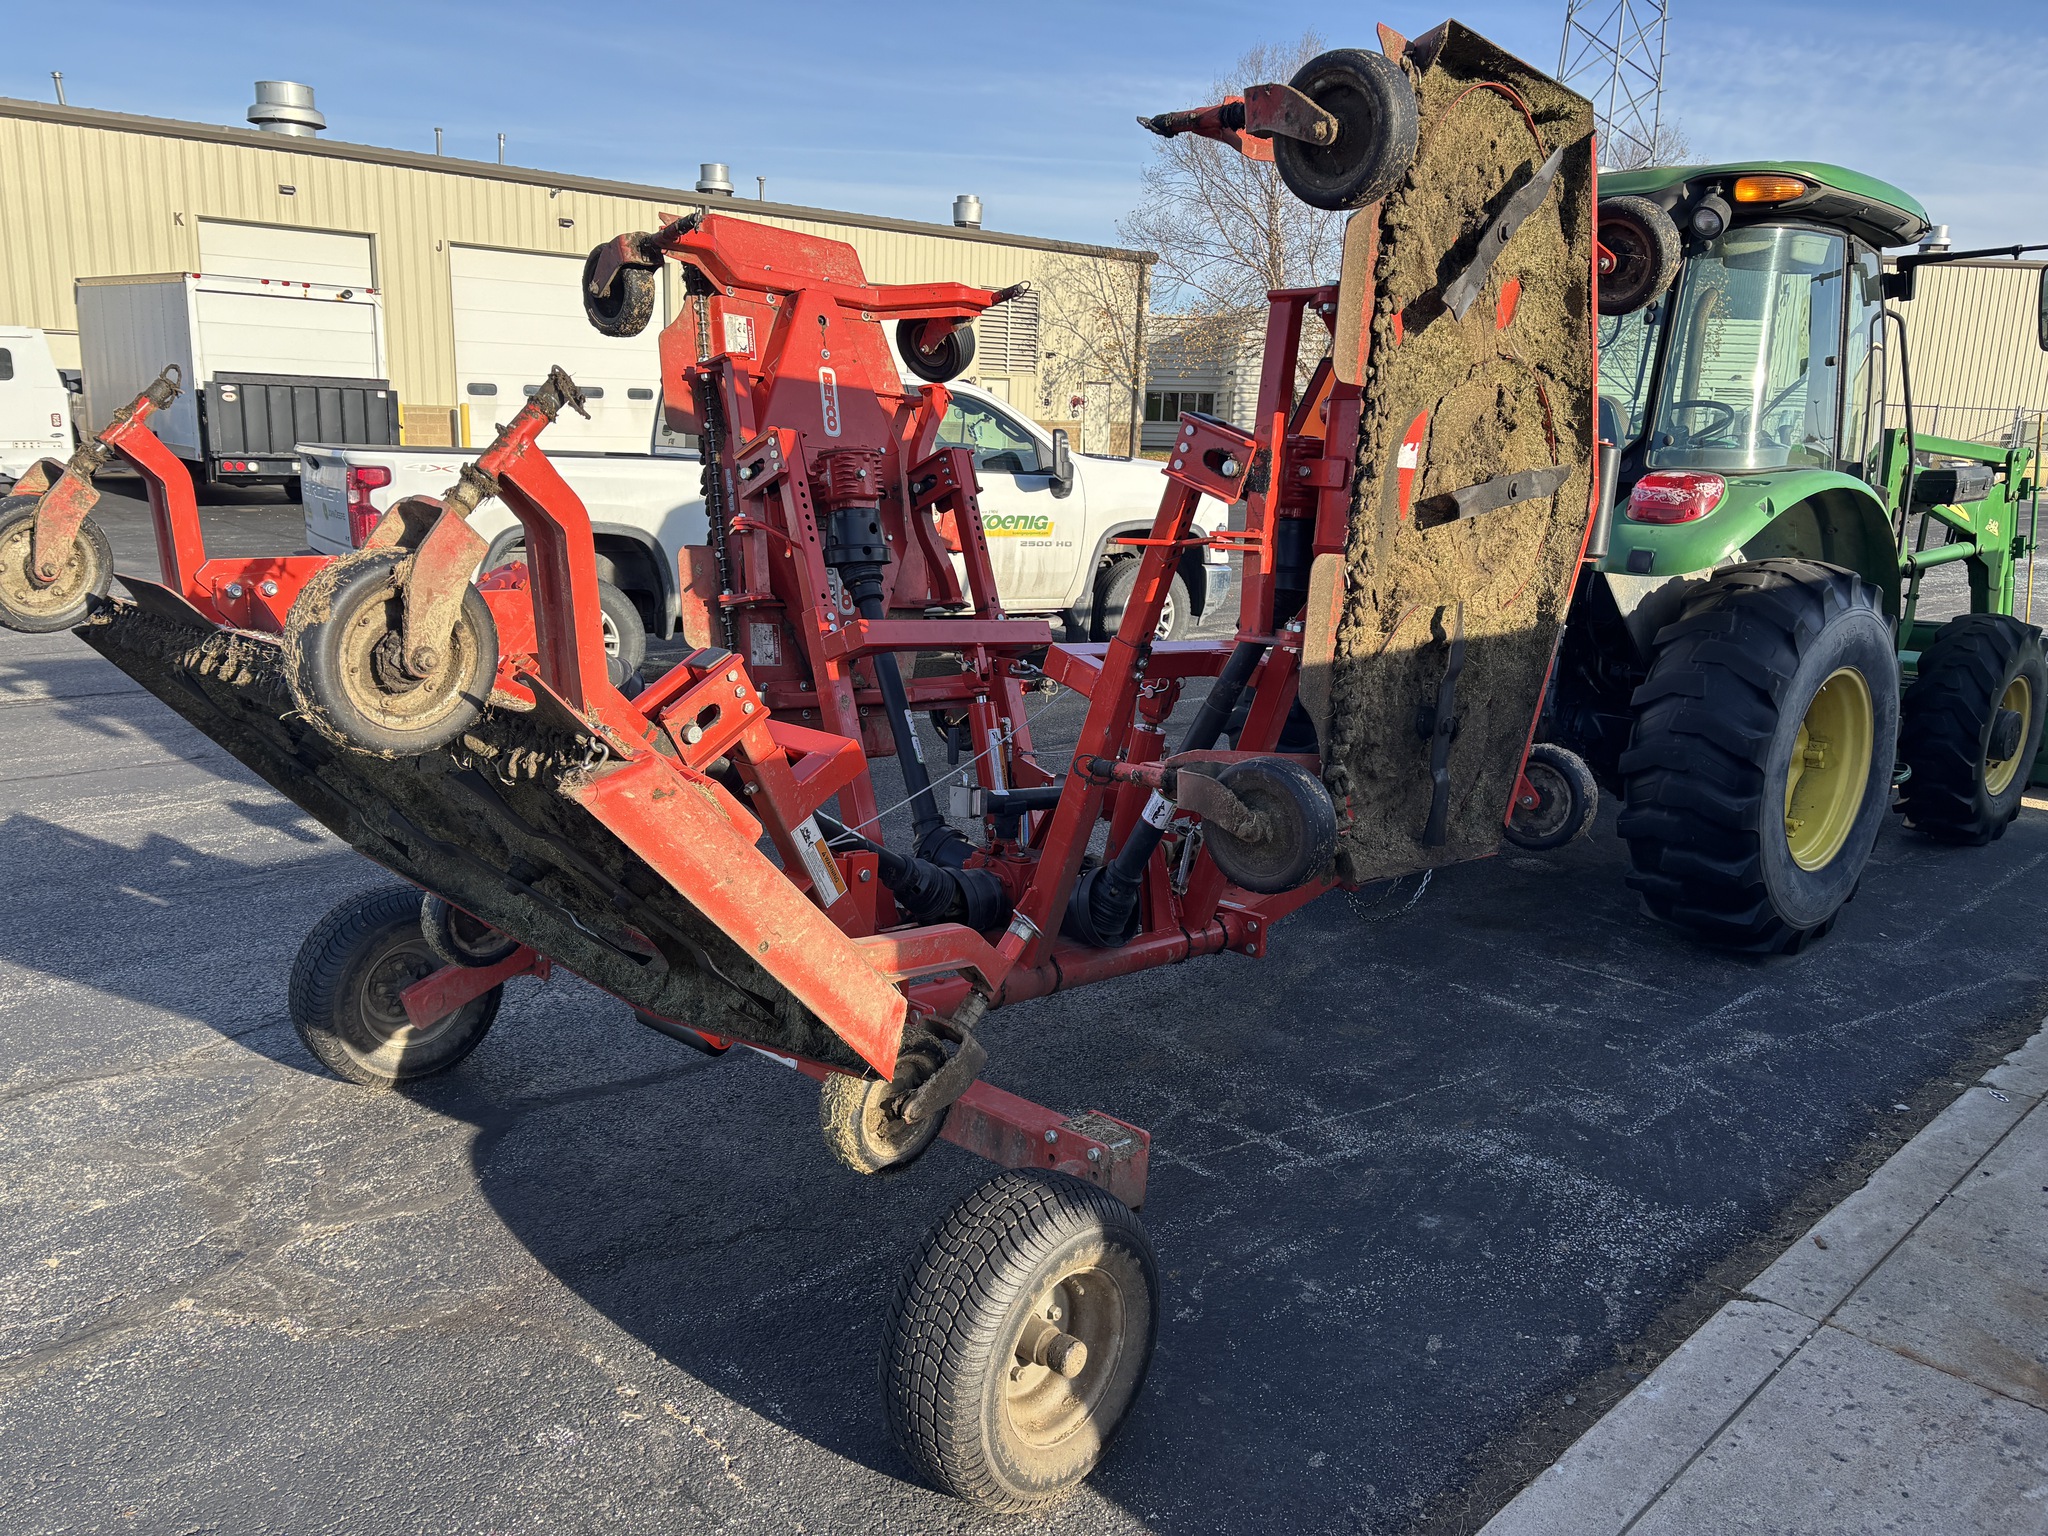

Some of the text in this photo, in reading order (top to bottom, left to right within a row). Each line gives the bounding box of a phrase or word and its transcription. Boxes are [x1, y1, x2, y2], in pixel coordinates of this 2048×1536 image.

[173, 212, 185, 226] K
[435, 239, 443, 252] J
[822, 372, 838, 432] BEFCO
[825, 857, 840, 884] WARNING
